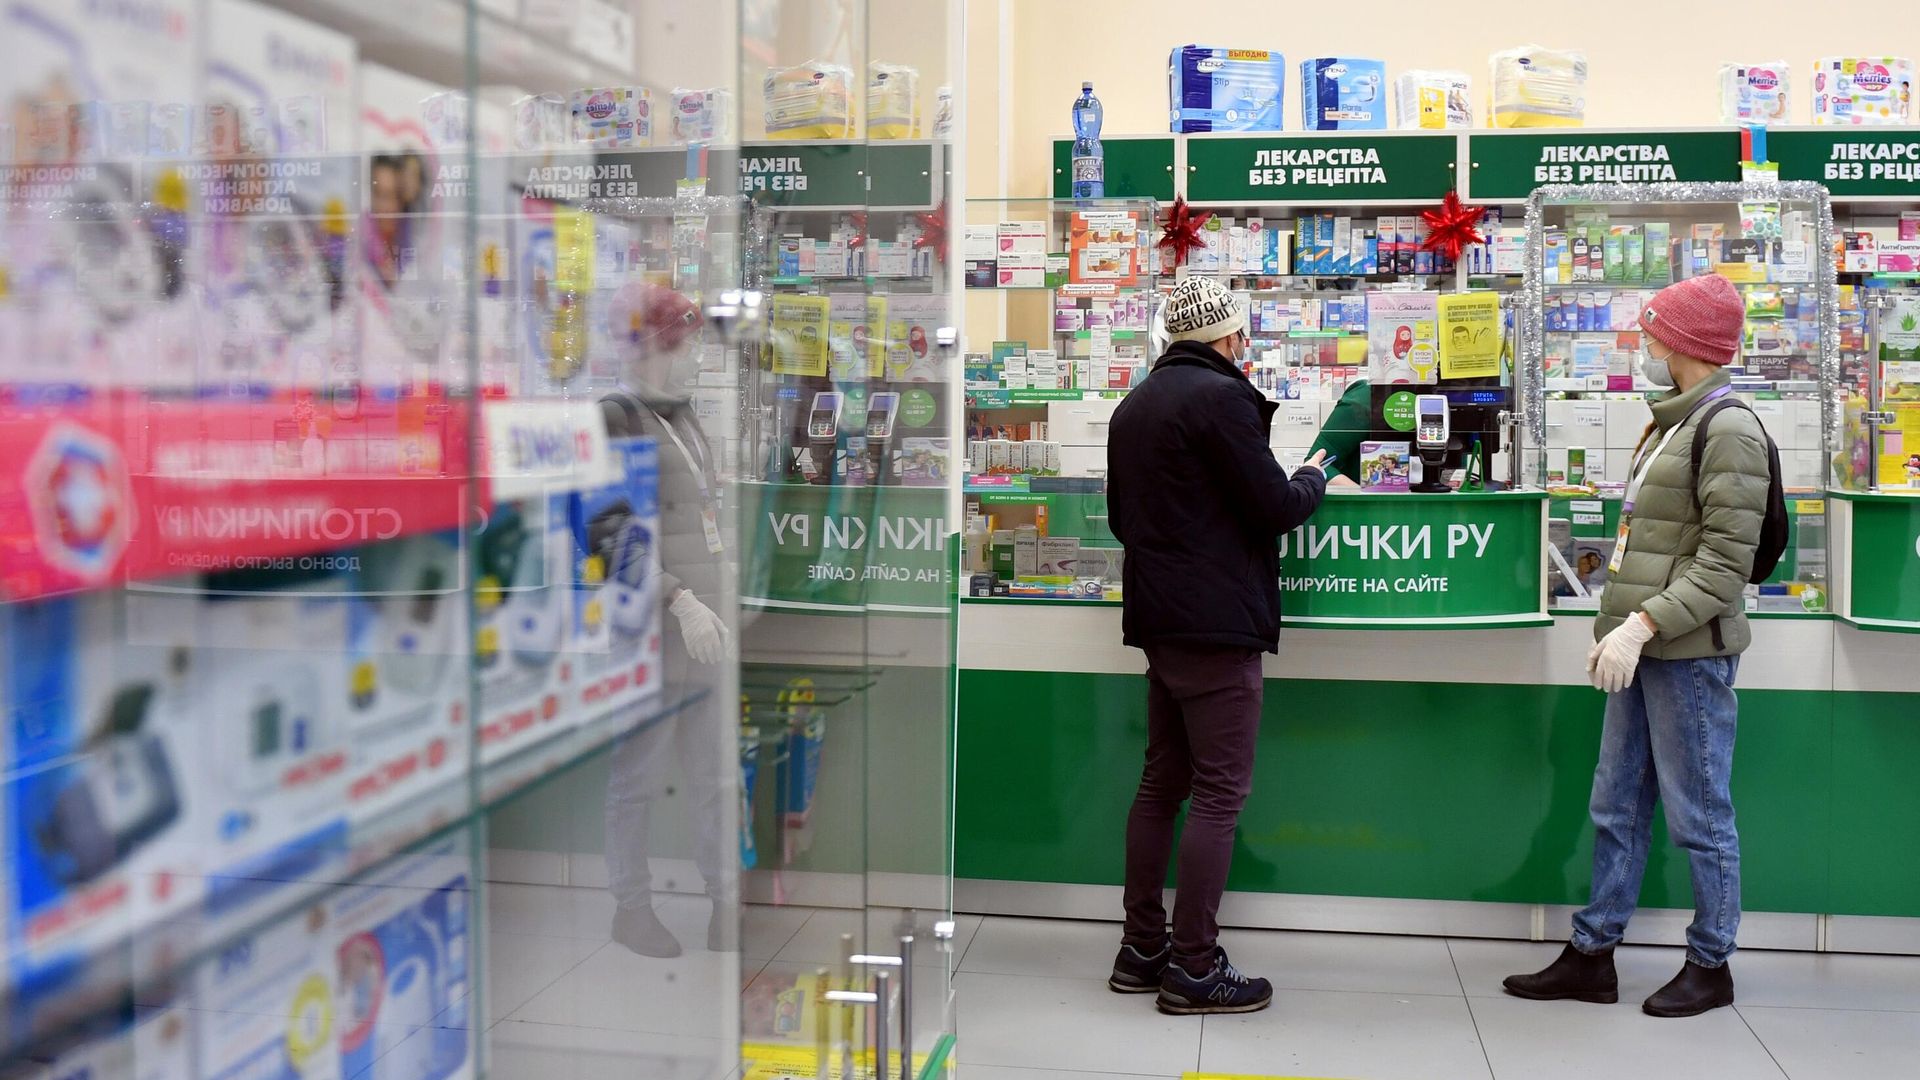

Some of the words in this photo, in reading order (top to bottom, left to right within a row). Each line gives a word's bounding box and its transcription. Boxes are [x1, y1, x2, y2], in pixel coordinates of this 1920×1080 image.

[1228, 50, 1268, 59] ВЫГОДНО
[1213, 77, 1230, 86] Slip
[1748, 76, 1779, 86] Merries
[1853, 72, 1892, 84] Merries
[1341, 103, 1362, 112] Pants
[1254, 148, 1380, 166] ЛЕКАРСТВА
[1540, 145, 1671, 163] ЛЕКАРСТВА
[1830, 142, 1920, 161] ЛЕКАРС
[1249, 169, 1287, 186] БЕЗ
[1292, 167, 1388, 187] РЕЦЕПТА
[1534, 165, 1574, 183] БЕЗ
[1578, 163, 1678, 183] РЕЦЕПТА
[1824, 163, 1864, 180] БЕЗ
[1749, 357, 1789, 365] ВЕНАРУС
[1447, 523, 1495, 559] РУ
[1363, 578, 1389, 593] НА
[1393, 573, 1449, 593] САЙТЕ
